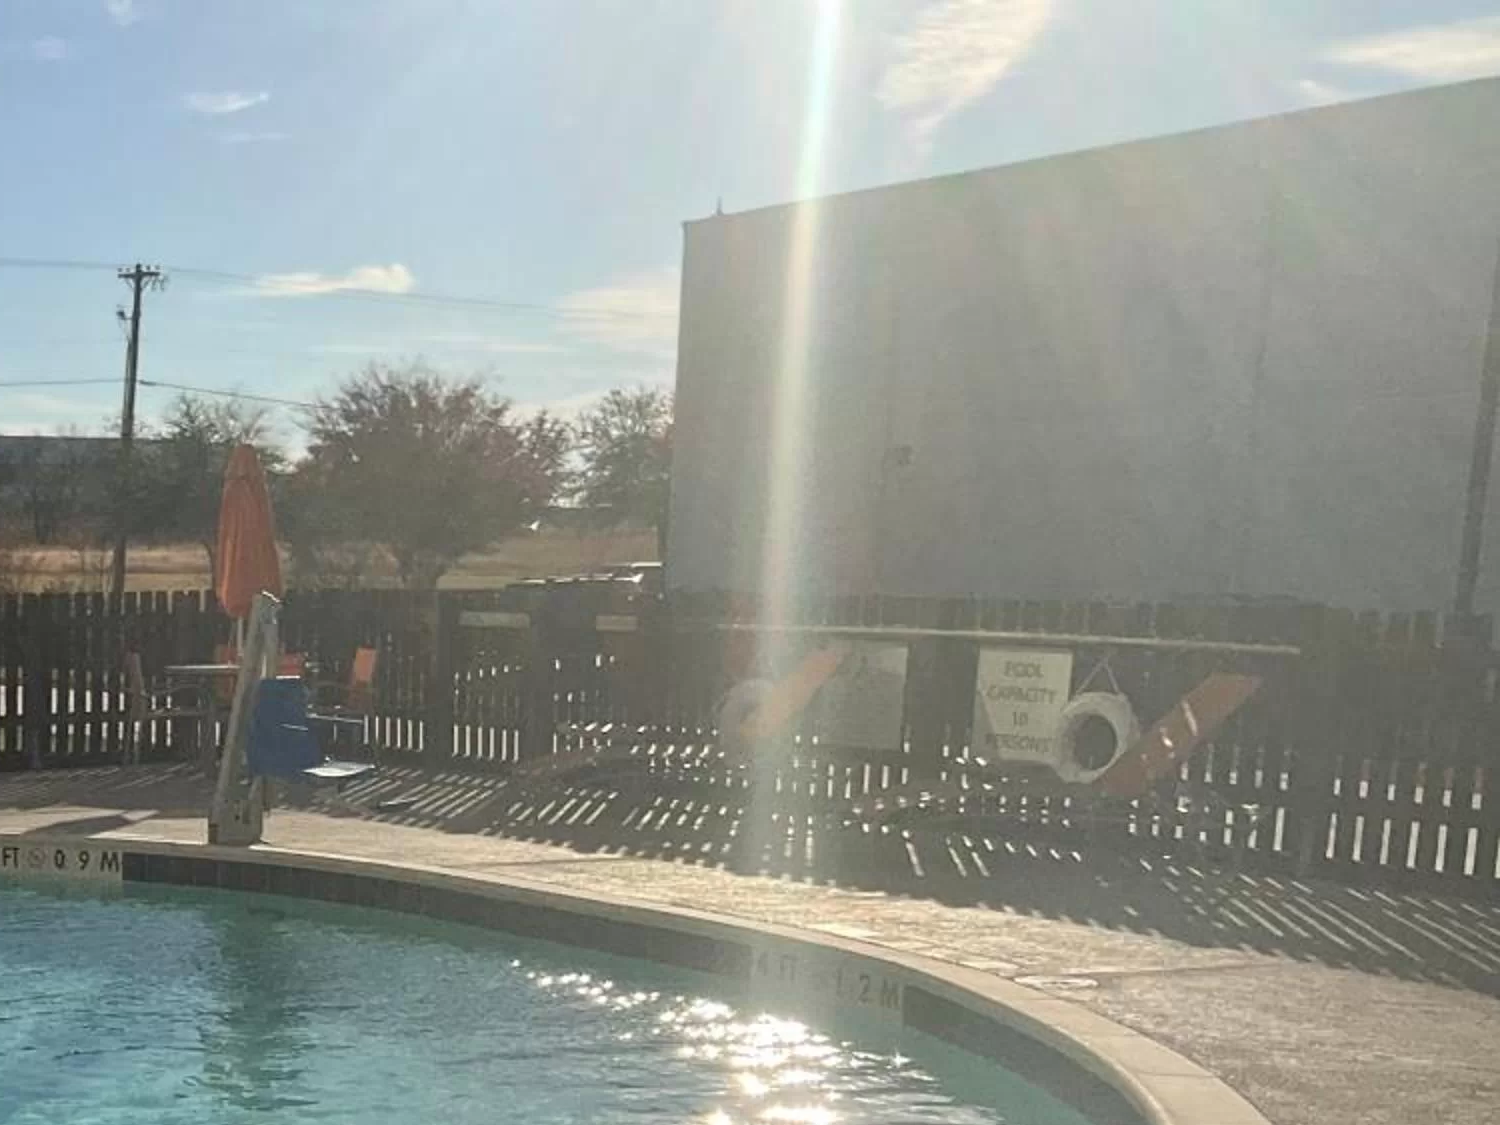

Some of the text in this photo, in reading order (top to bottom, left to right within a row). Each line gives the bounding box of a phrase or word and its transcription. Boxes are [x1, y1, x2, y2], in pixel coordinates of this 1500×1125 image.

[1003, 661, 1044, 678] POOL
[986, 685, 1057, 704] CAPACITY
[2, 847, 20, 869] FT
[99, 851, 120, 873] M
